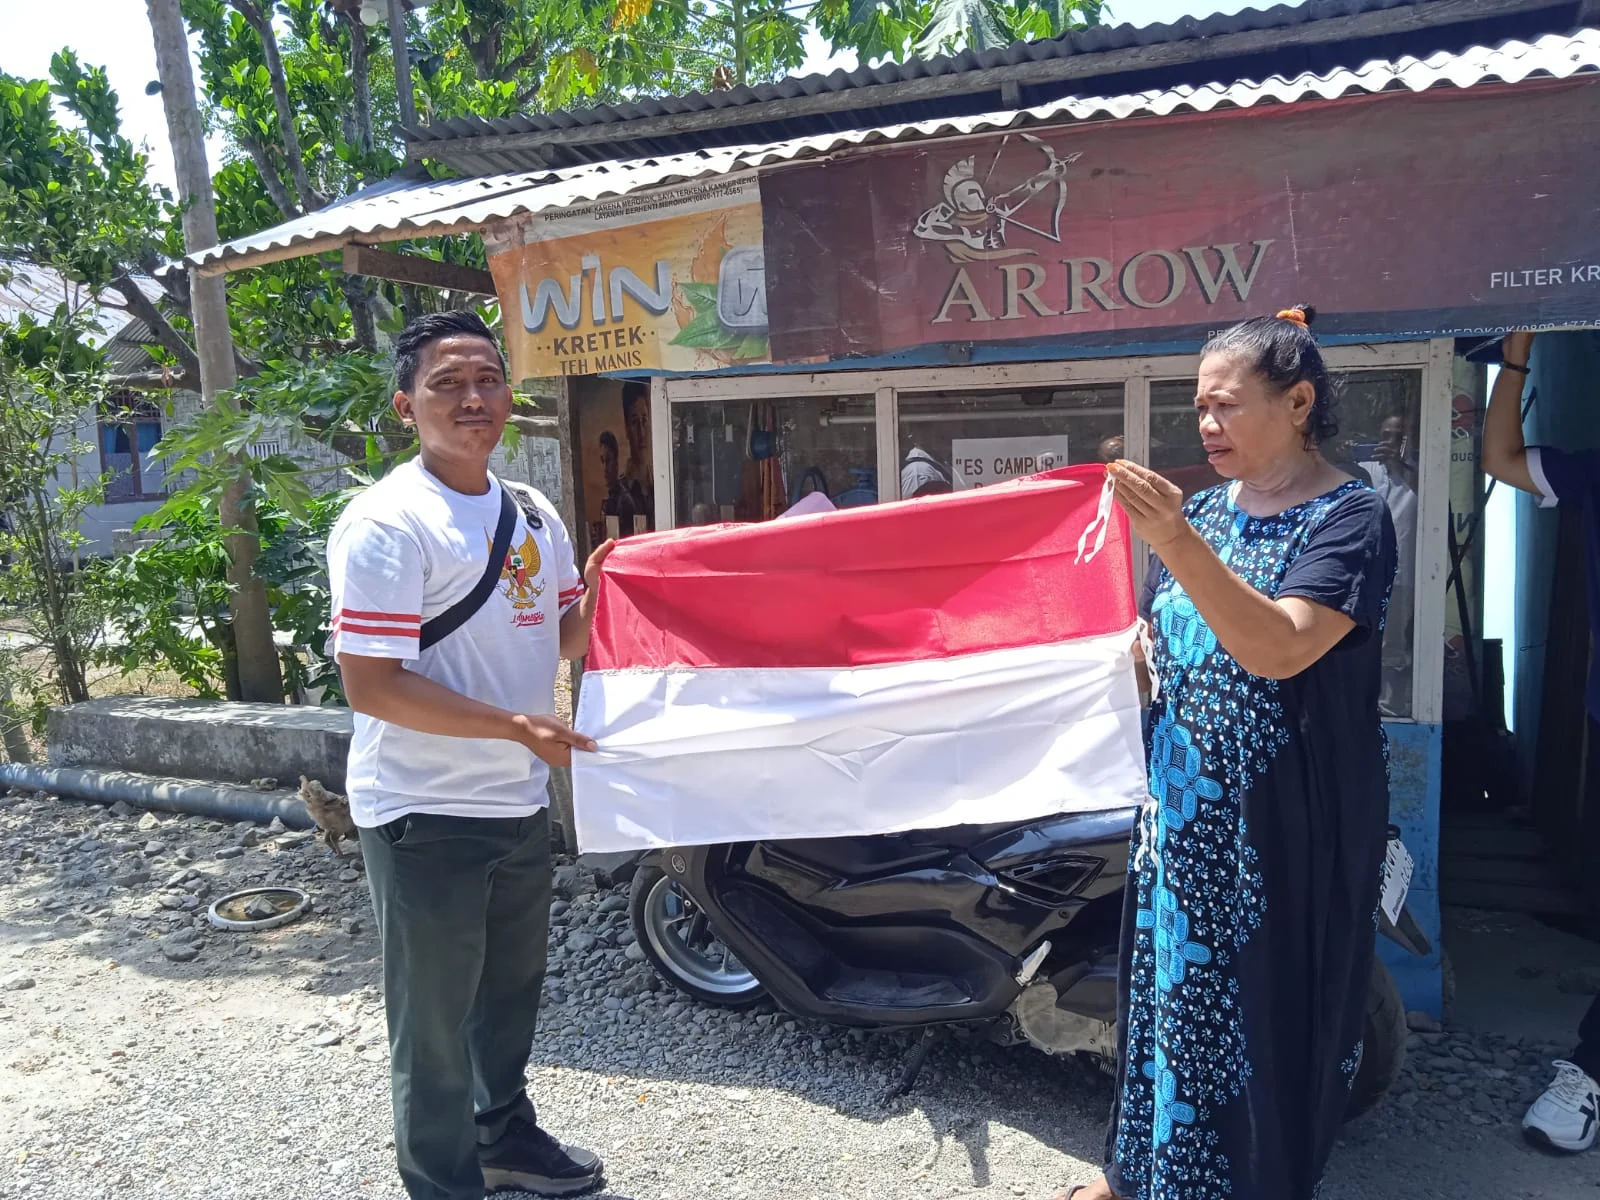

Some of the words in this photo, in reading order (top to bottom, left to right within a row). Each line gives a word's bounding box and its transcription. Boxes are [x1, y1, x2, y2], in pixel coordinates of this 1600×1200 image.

[594, 200, 621, 213] KARENA
[676, 185, 707, 198] TERKENA
[594, 209, 624, 220] LAYANAN
[625, 203, 658, 215] BERHENTI
[931, 239, 1275, 325] ARROW
[1490, 268, 1562, 289] FILTER
[520, 255, 671, 334] WIN
[553, 325, 645, 356] KRETEK
[559, 359, 588, 375] TEH
[595, 350, 642, 374] MANIS
[955, 458, 984, 476] "ES
[993, 455, 1063, 476] CAMPUR"
